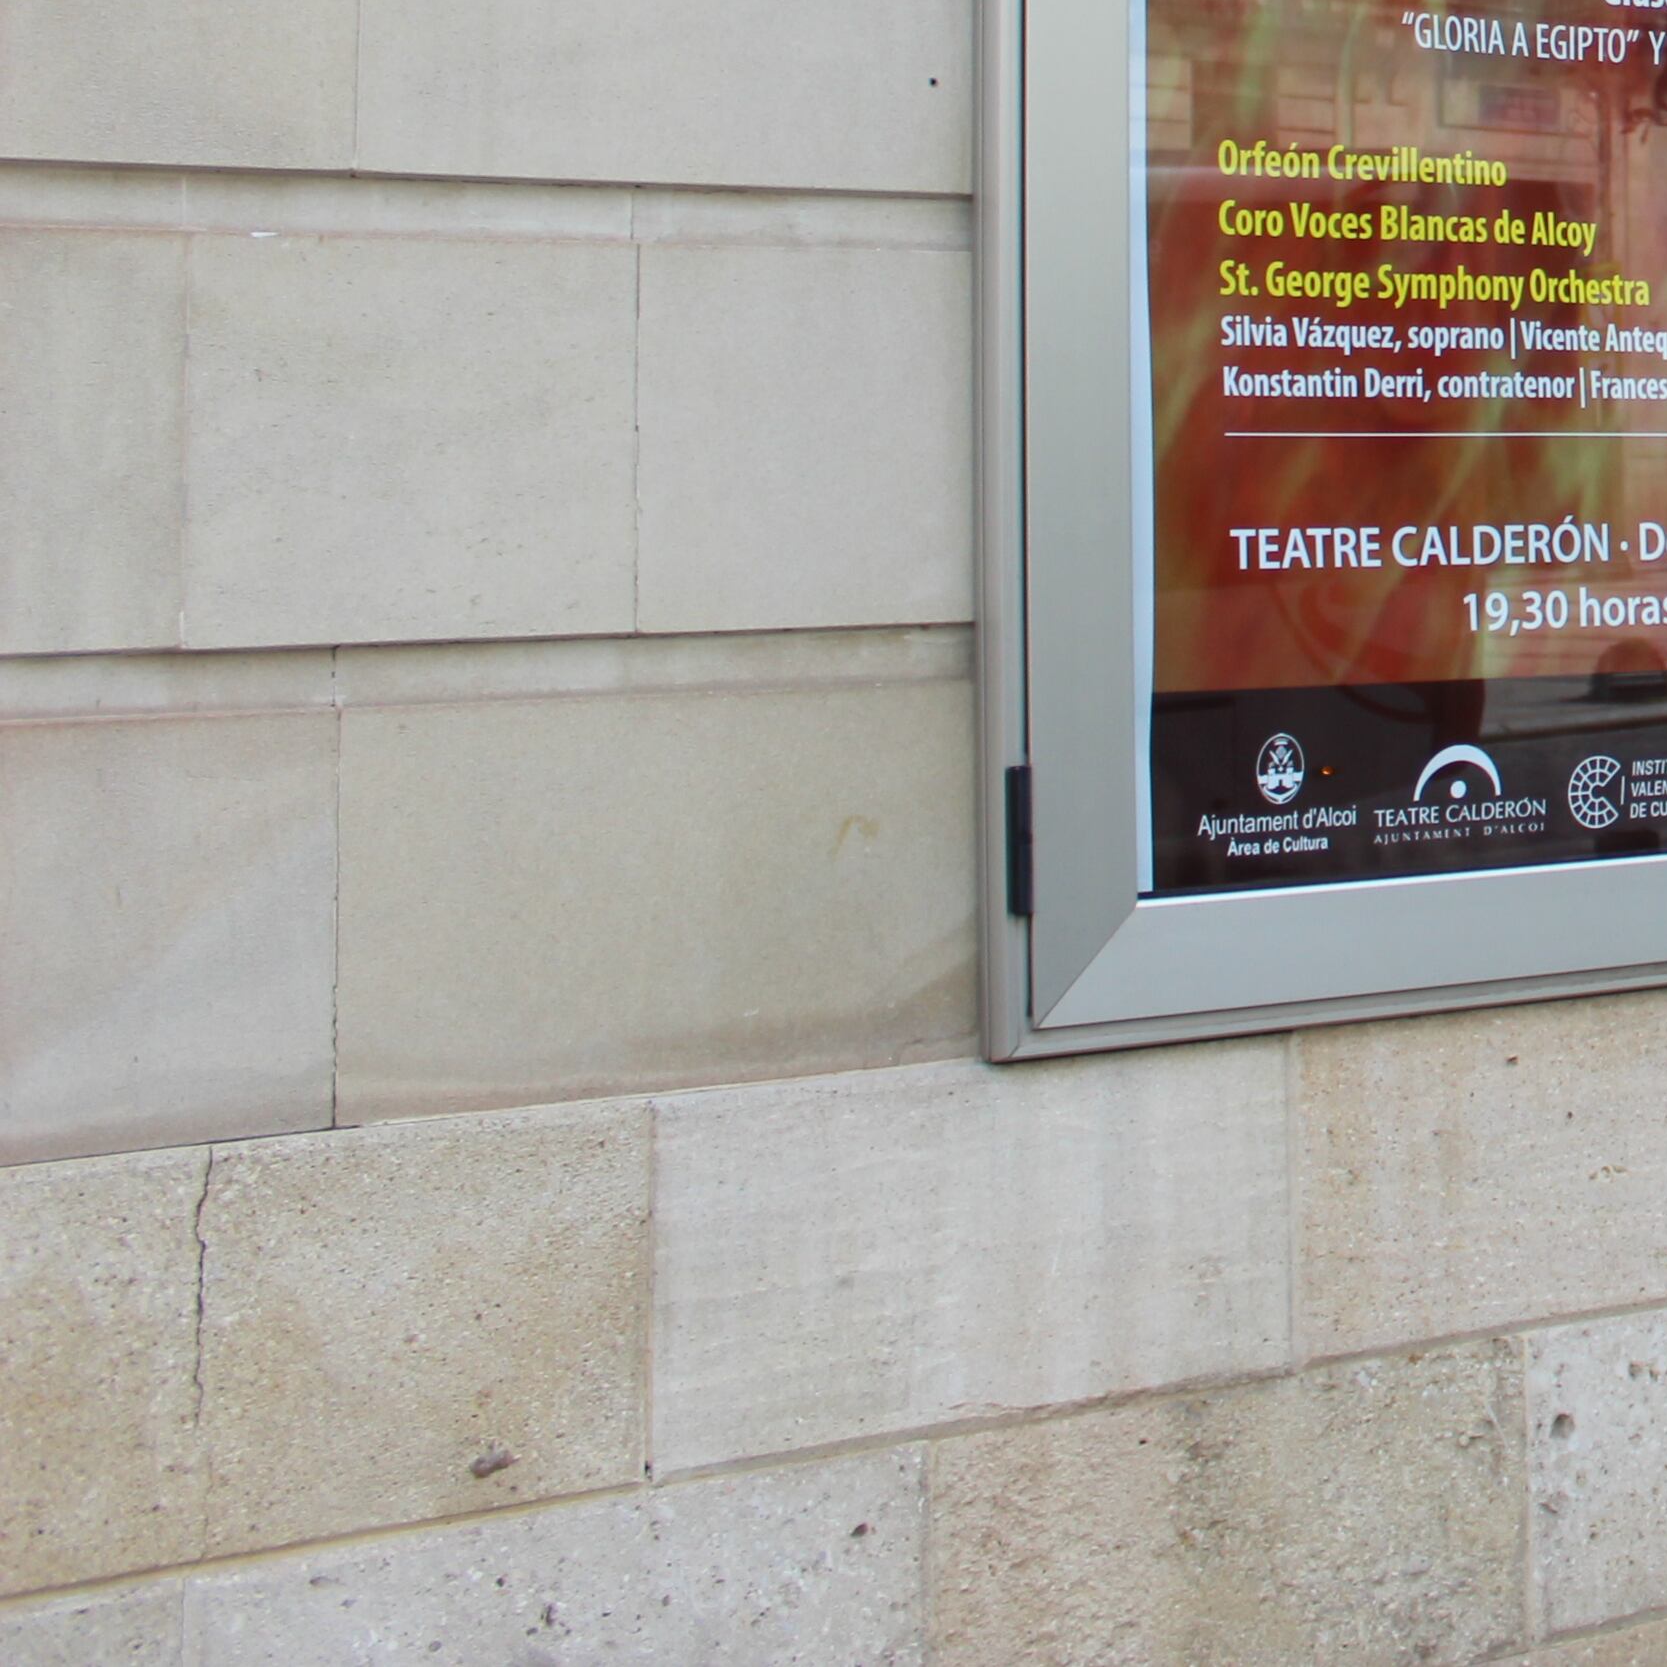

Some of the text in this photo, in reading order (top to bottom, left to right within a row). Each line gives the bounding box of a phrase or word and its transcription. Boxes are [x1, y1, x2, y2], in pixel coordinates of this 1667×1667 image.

[1512, 22, 1530, 57] A
[1648, 29, 1666, 65] Y
[1218, 140, 1507, 188] Orfeón Crevillentino
[1218, 200, 1598, 256] Coro Voces Blancas de Alcoy
[1220, 259, 1650, 311] St. George Symphony Orchestra
[1220, 315, 1288, 349] Silvia
[1292, 316, 1402, 356] Vázquez,
[1407, 327, 1505, 357] soprano
[1520, 321, 1600, 352] Vicente
[1222, 366, 1358, 399] Konstantin
[1363, 366, 1432, 403] Derri,
[1437, 371, 1576, 400] contratenor
[1230, 525, 1382, 572] TEATRE
[1391, 514, 1611, 568] CALDERÓN
[1463, 592, 1569, 635] 19,30
[1197, 804, 1357, 838] Ajuntament d'Alcoi
[1374, 797, 1547, 828] TEATRE CALDERÓN
[1630, 803, 1647, 818] DE
[1227, 833, 1329, 857] Àrea de Cultura
[1374, 828, 1471, 844] AJUNTAMENT
